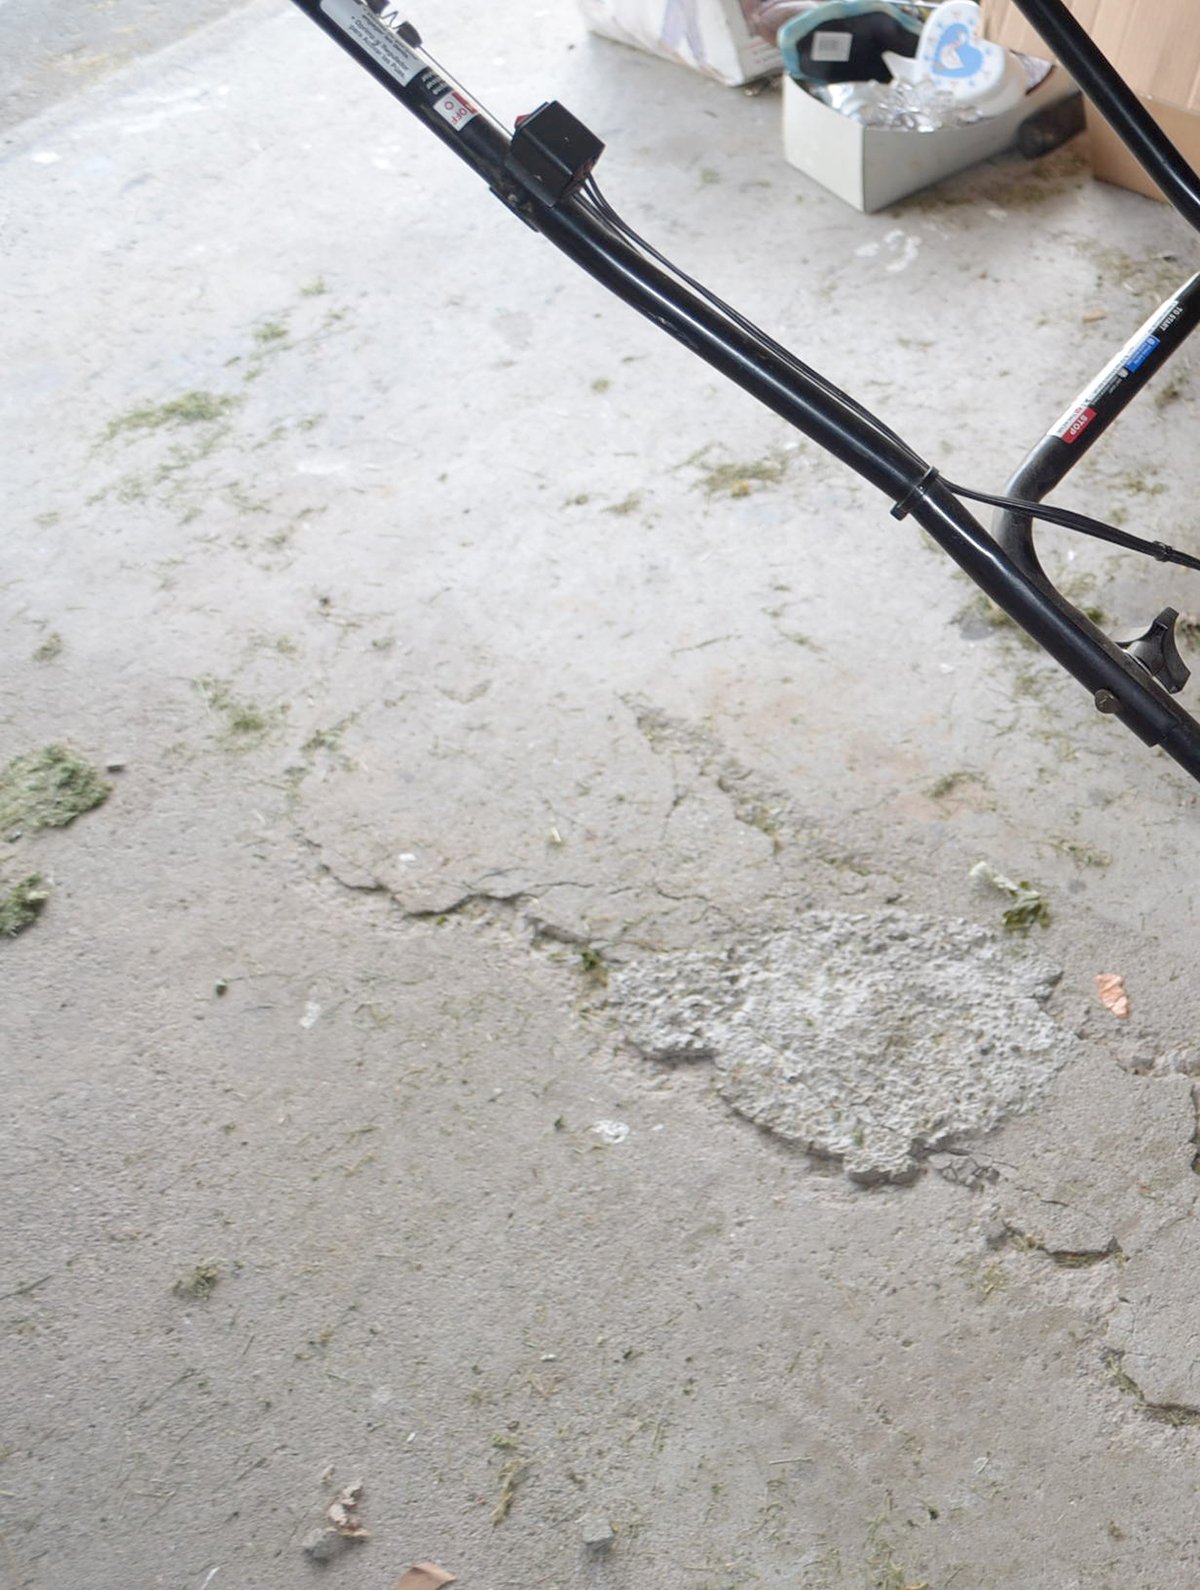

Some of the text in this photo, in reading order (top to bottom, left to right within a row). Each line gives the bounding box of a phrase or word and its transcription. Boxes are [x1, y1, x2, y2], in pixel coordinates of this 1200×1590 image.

[449, 106, 469, 126] OFF
[1172, 305, 1183, 317] TO
[1159, 312, 1177, 332] START
[1068, 413, 1089, 437] STOP
